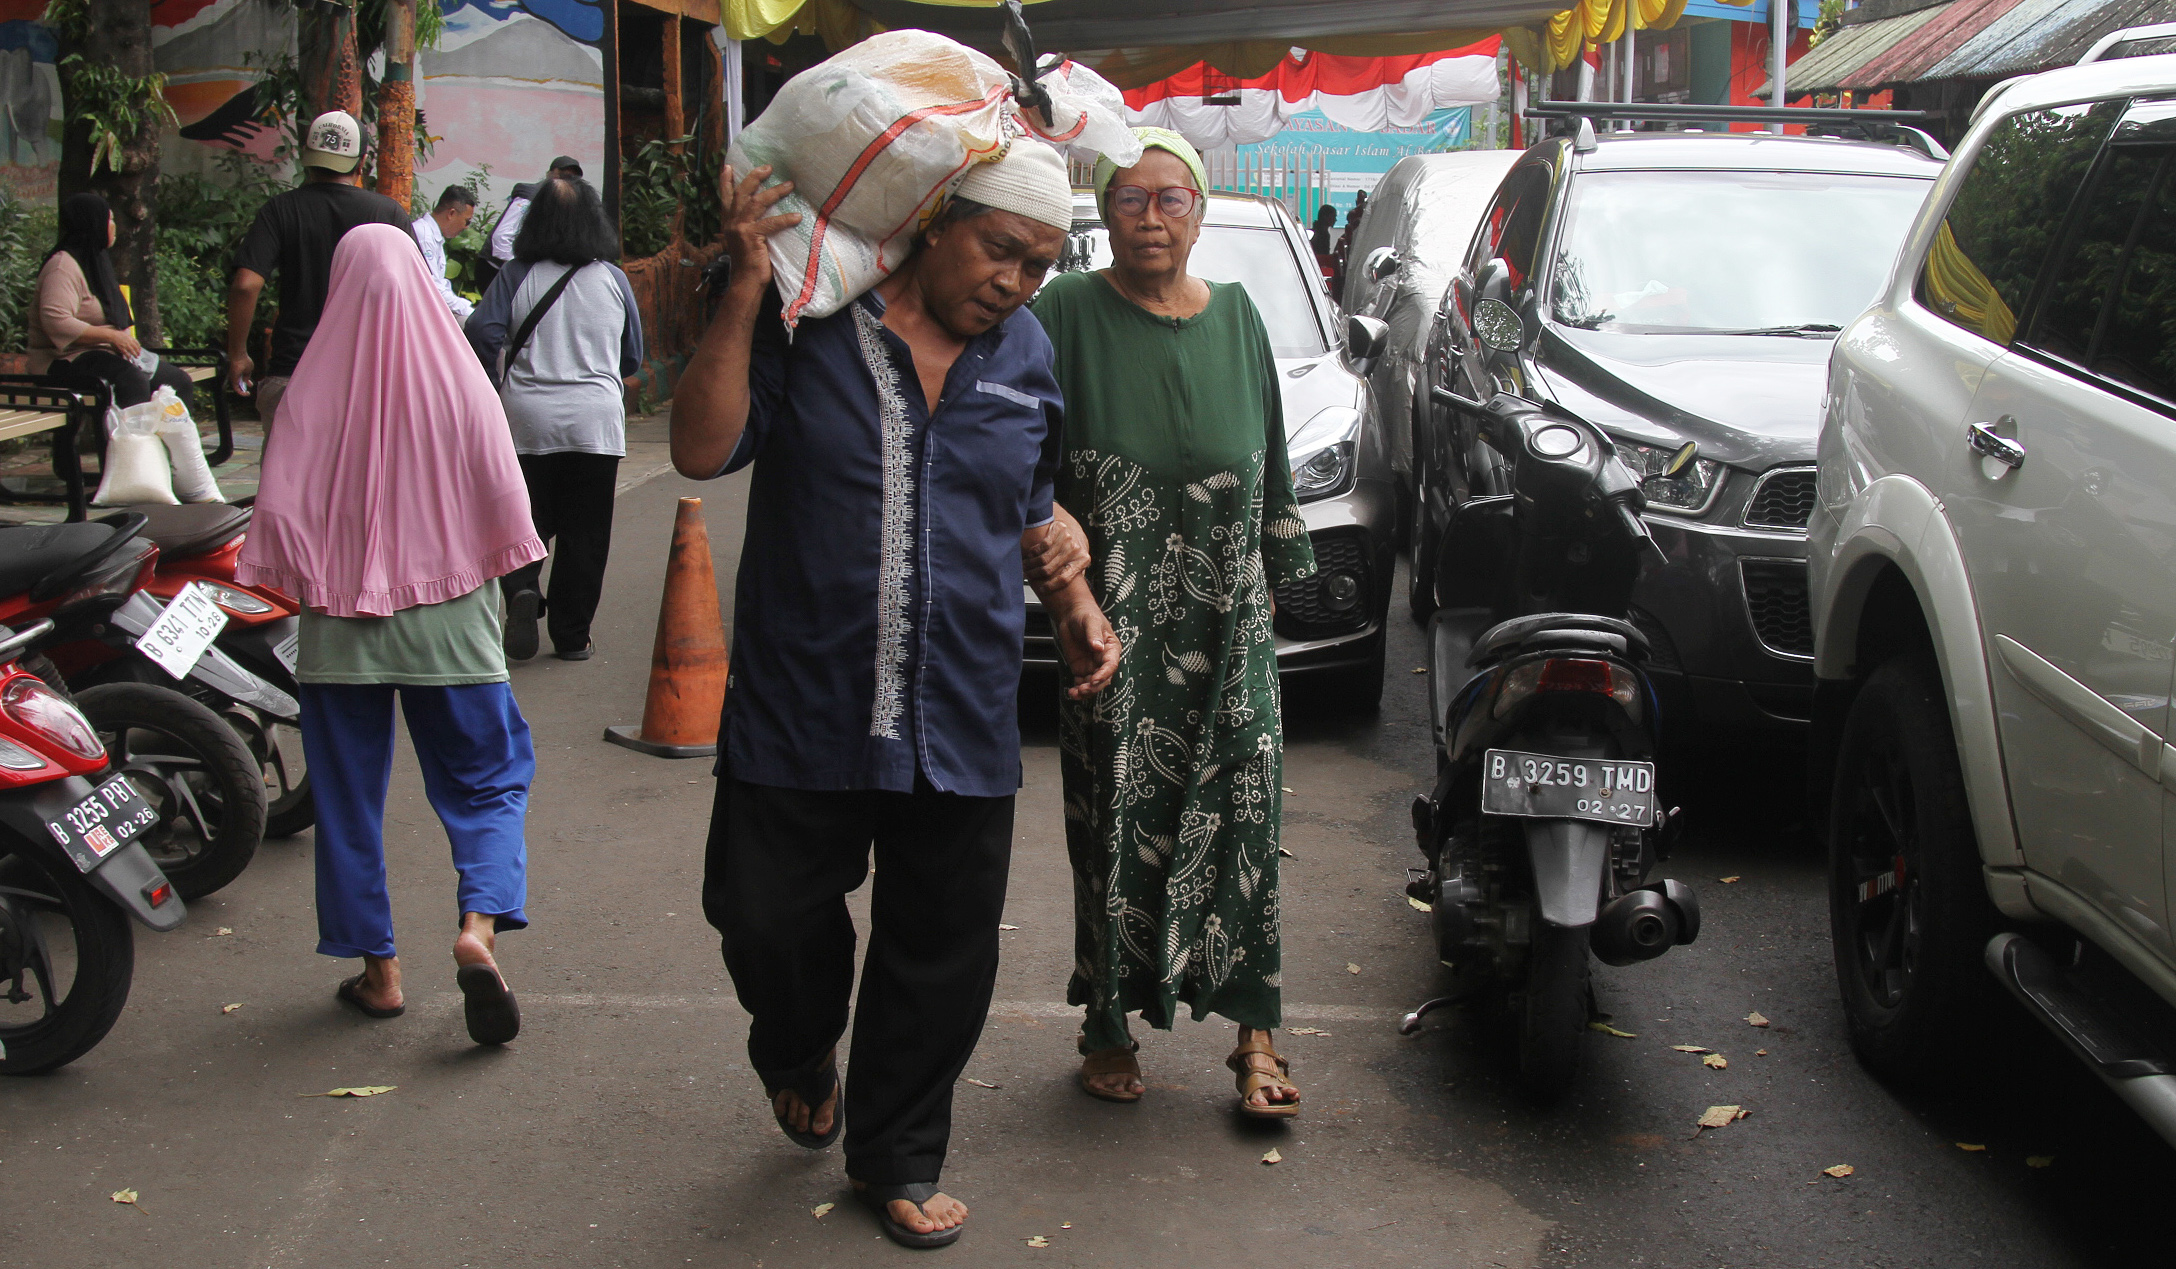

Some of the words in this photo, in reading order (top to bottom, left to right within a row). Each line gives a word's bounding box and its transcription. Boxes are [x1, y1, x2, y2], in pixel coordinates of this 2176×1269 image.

[1282, 118, 1348, 132] AYASAN
[326, 134, 337, 144] 75
[1255, 141, 1306, 156] Sekolah
[1311, 143, 1350, 155] Dasar
[1354, 143, 1389, 156] Islam
[1392, 144, 1413, 158] Al
[144, 642, 163, 659] B
[156, 614, 188, 646] 6341
[179, 591, 208, 618] TTN
[1491, 755, 1505, 779] B
[1523, 759, 1587, 788] 3259
[1601, 767, 1651, 793] TMD
[50, 822, 70, 845] B
[66, 795, 109, 834] 3255
[100, 776, 138, 810] PBT
